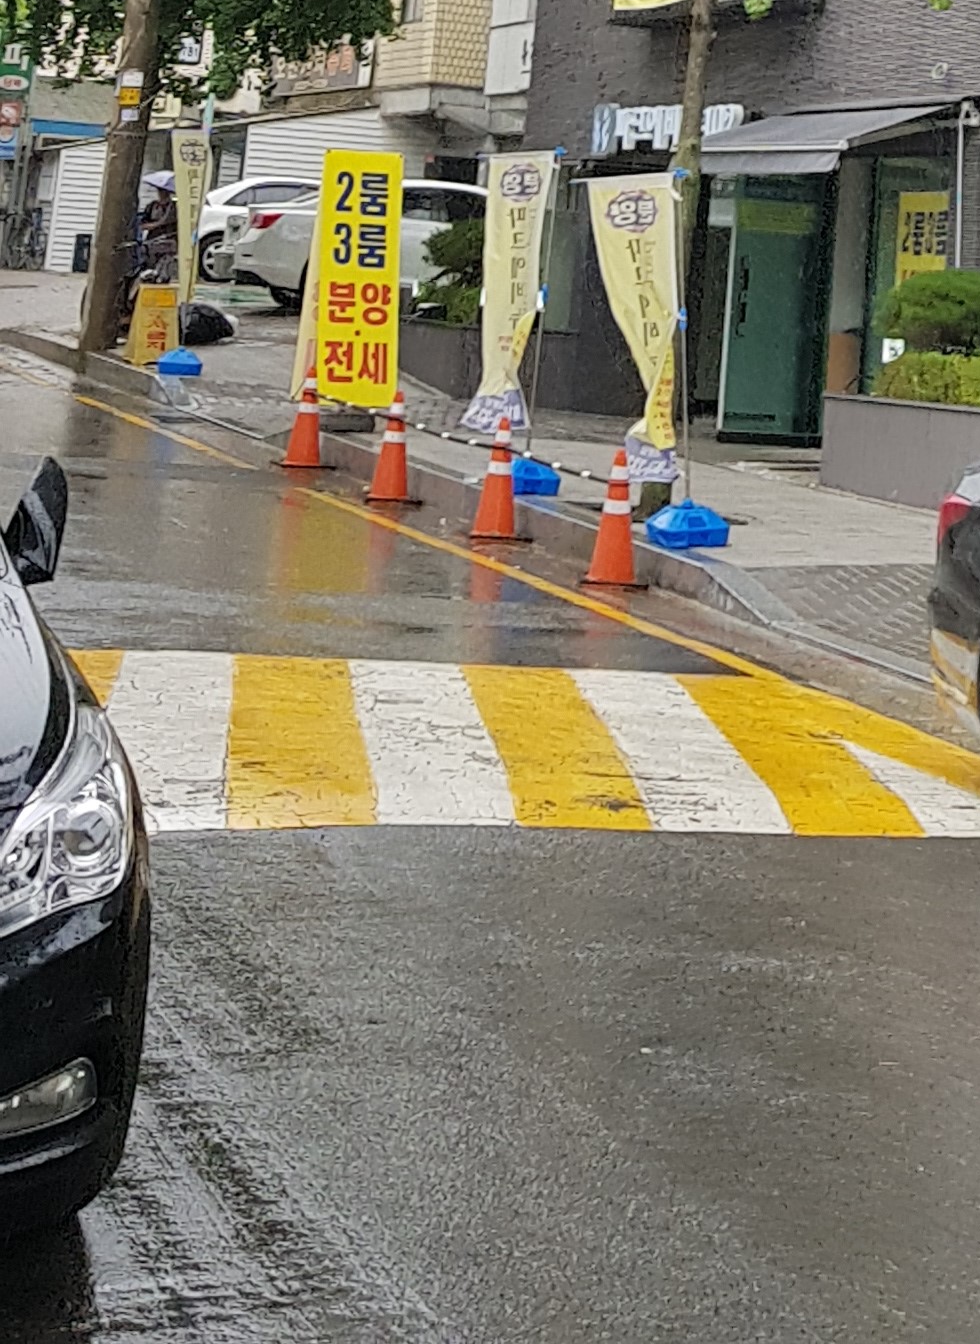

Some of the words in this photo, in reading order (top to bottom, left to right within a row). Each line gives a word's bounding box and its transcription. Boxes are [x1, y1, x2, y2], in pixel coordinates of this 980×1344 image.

[334, 171, 390, 216] 2룸
[334, 223, 388, 268] 3룸
[328, 282, 391, 326] 분양
[324, 340, 388, 385] 전세
